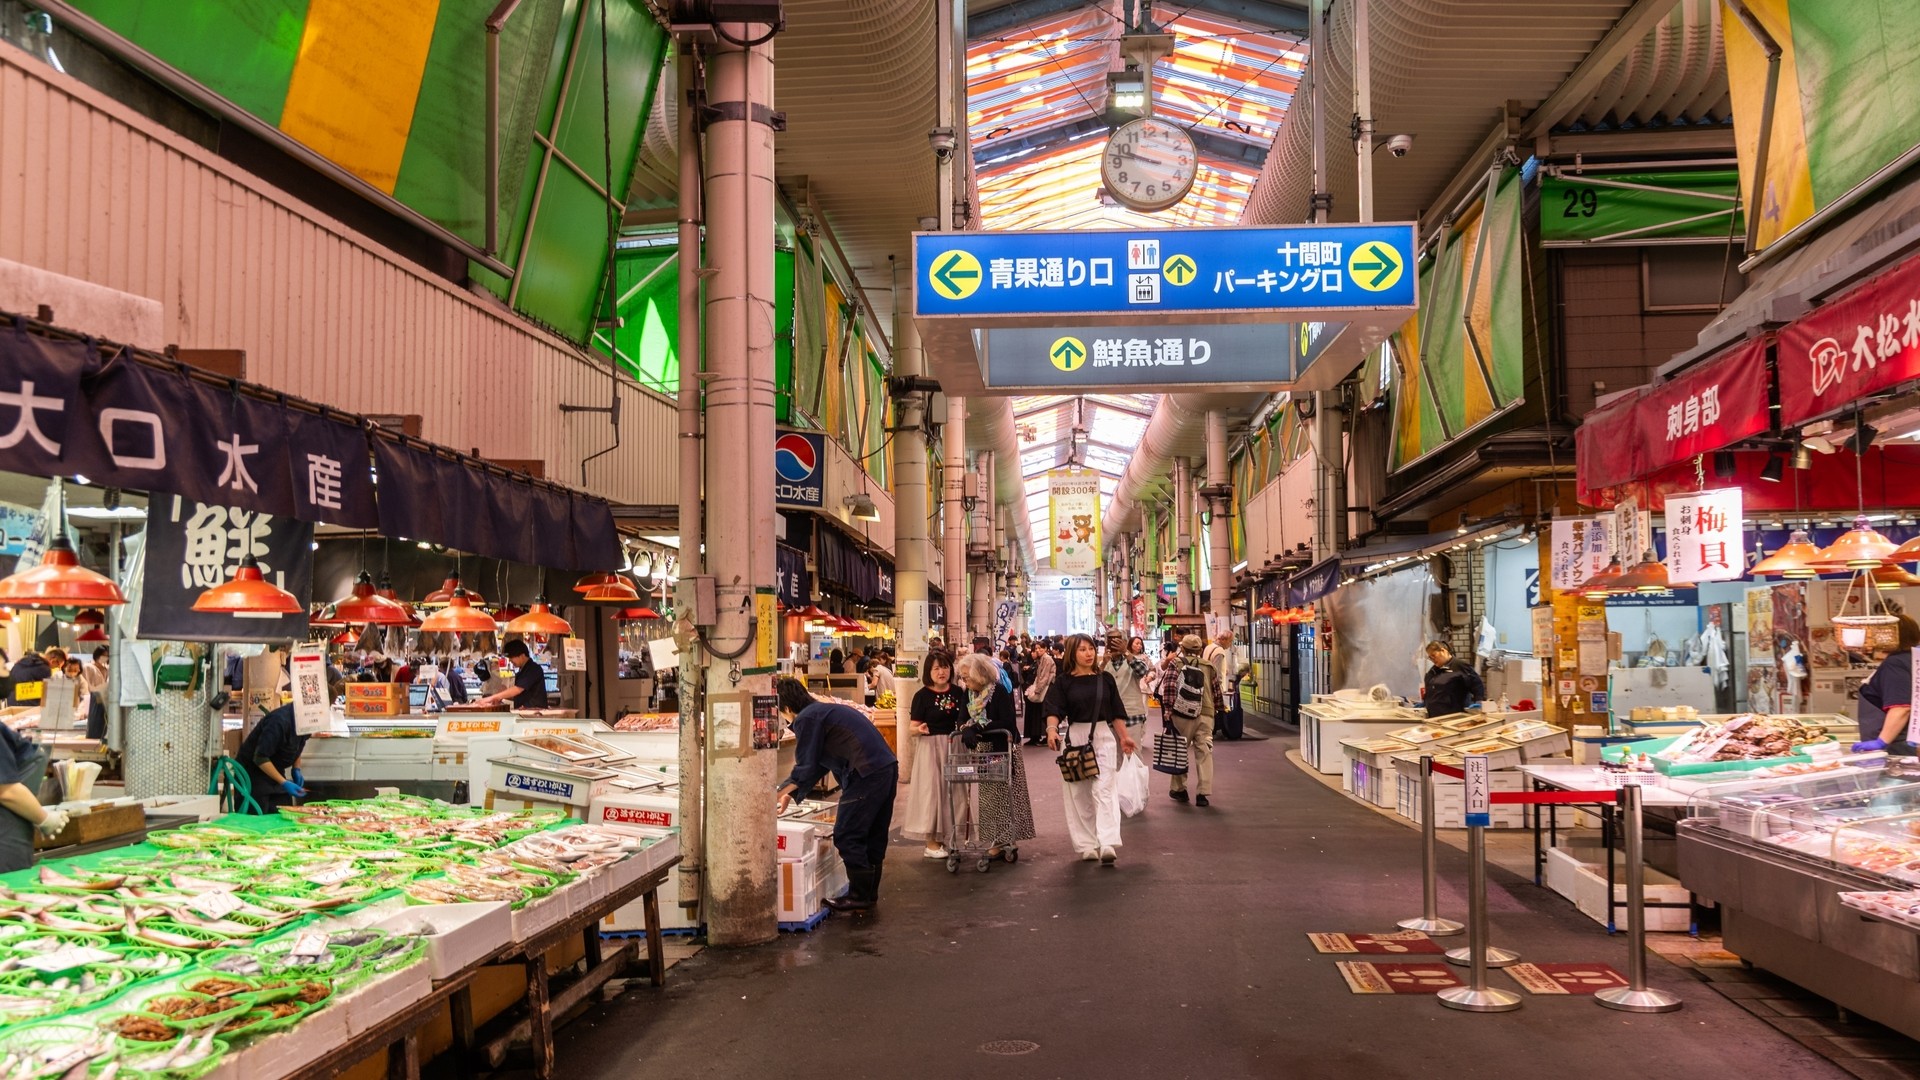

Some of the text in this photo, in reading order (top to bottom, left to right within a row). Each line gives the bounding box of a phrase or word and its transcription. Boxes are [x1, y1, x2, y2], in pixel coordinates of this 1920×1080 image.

[1563, 188, 1598, 218] 29
[1277, 241, 1343, 267] 十間町
[989, 257, 1114, 290] 青果通り口
[1213, 269, 1343, 294] パーキング口
[1092, 338, 1212, 367] 鮮魚通り
[1665, 384, 1720, 441] 刺身部
[1051, 486, 1098, 495] 開設300年
[1591, 520, 1603, 553] 無添加
[1680, 505, 1692, 536] お刺身
[1671, 527, 1682, 574] 食べられます
[1694, 505, 1729, 572] 梅貝
[1560, 541, 1570, 586] 食べられます
[1470, 761, 1483, 809] 注文入口
